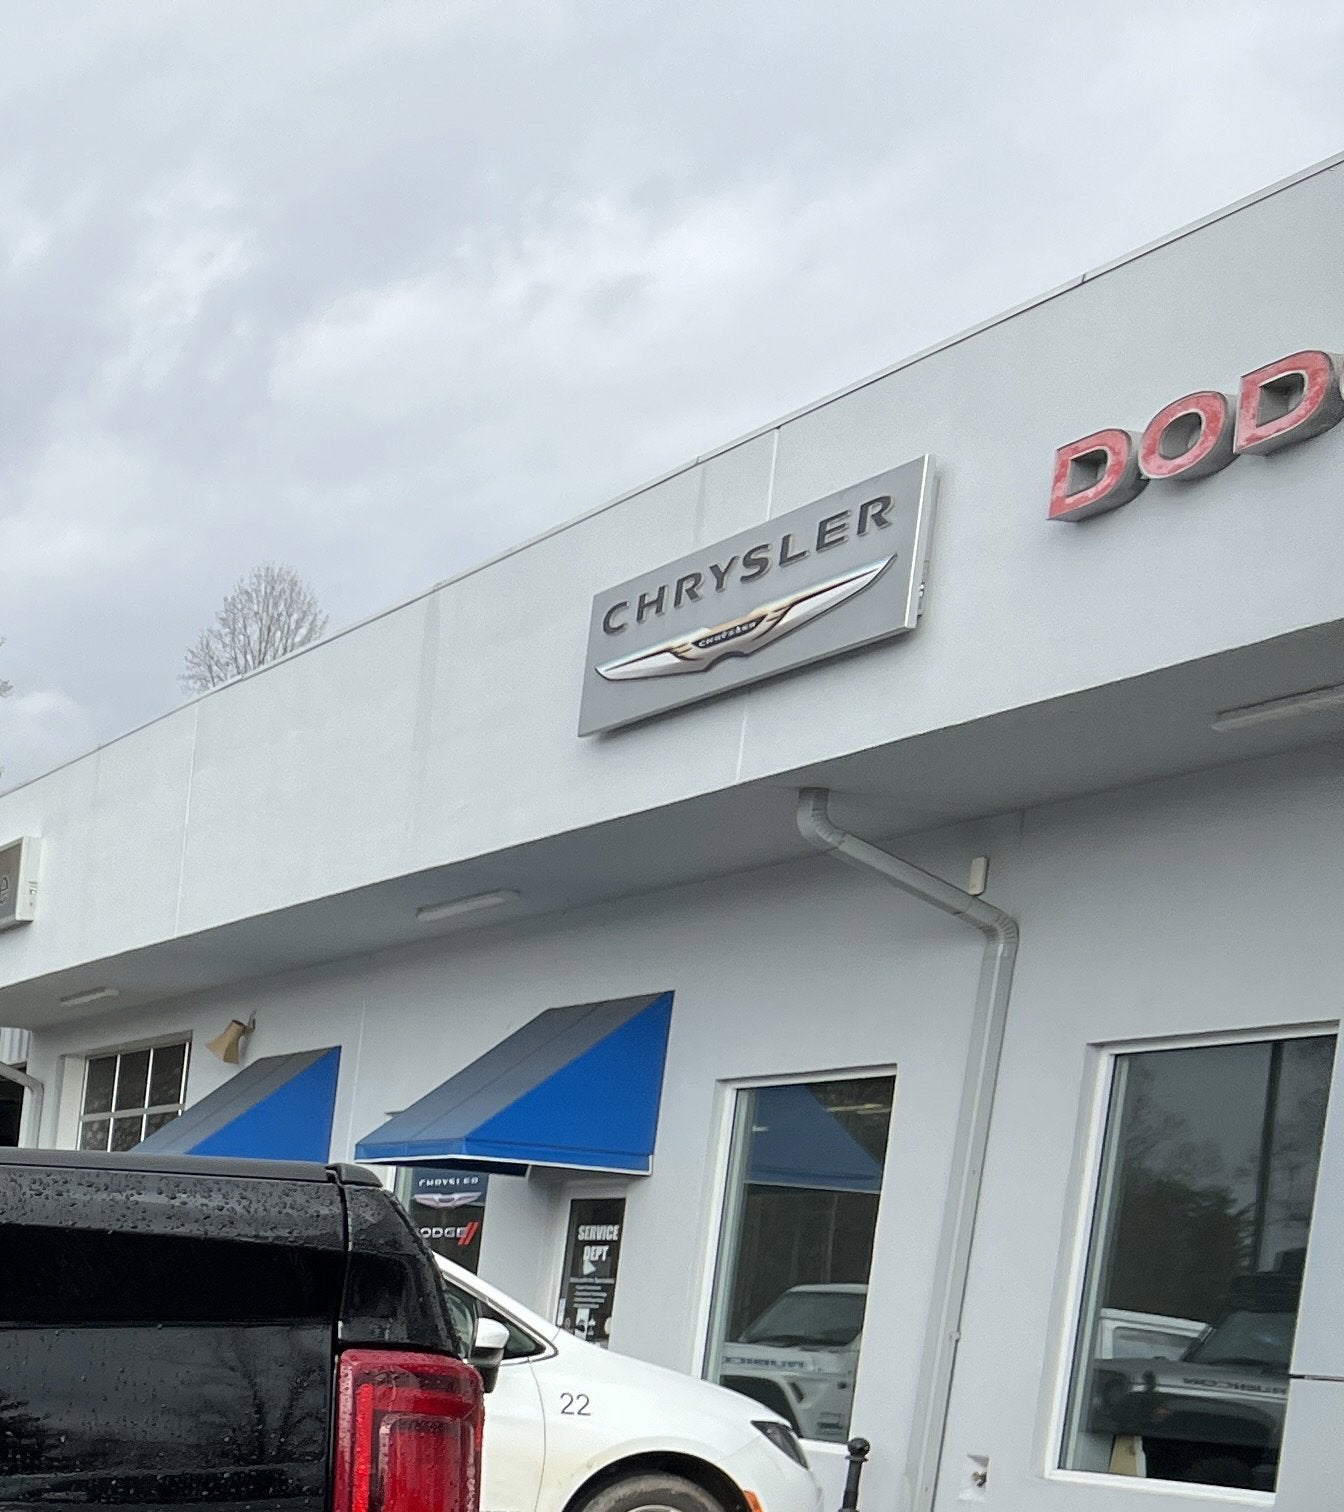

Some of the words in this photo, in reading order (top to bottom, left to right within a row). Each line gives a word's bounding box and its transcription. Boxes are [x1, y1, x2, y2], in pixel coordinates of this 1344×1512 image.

[1047, 349, 1344, 521] DOD
[602, 495, 894, 635] CHRYSLER
[418, 1226, 469, 1239] ODGE
[577, 1224, 620, 1241] SERVICE
[582, 1245, 609, 1262] DEPT
[560, 1392, 591, 1416] 22
